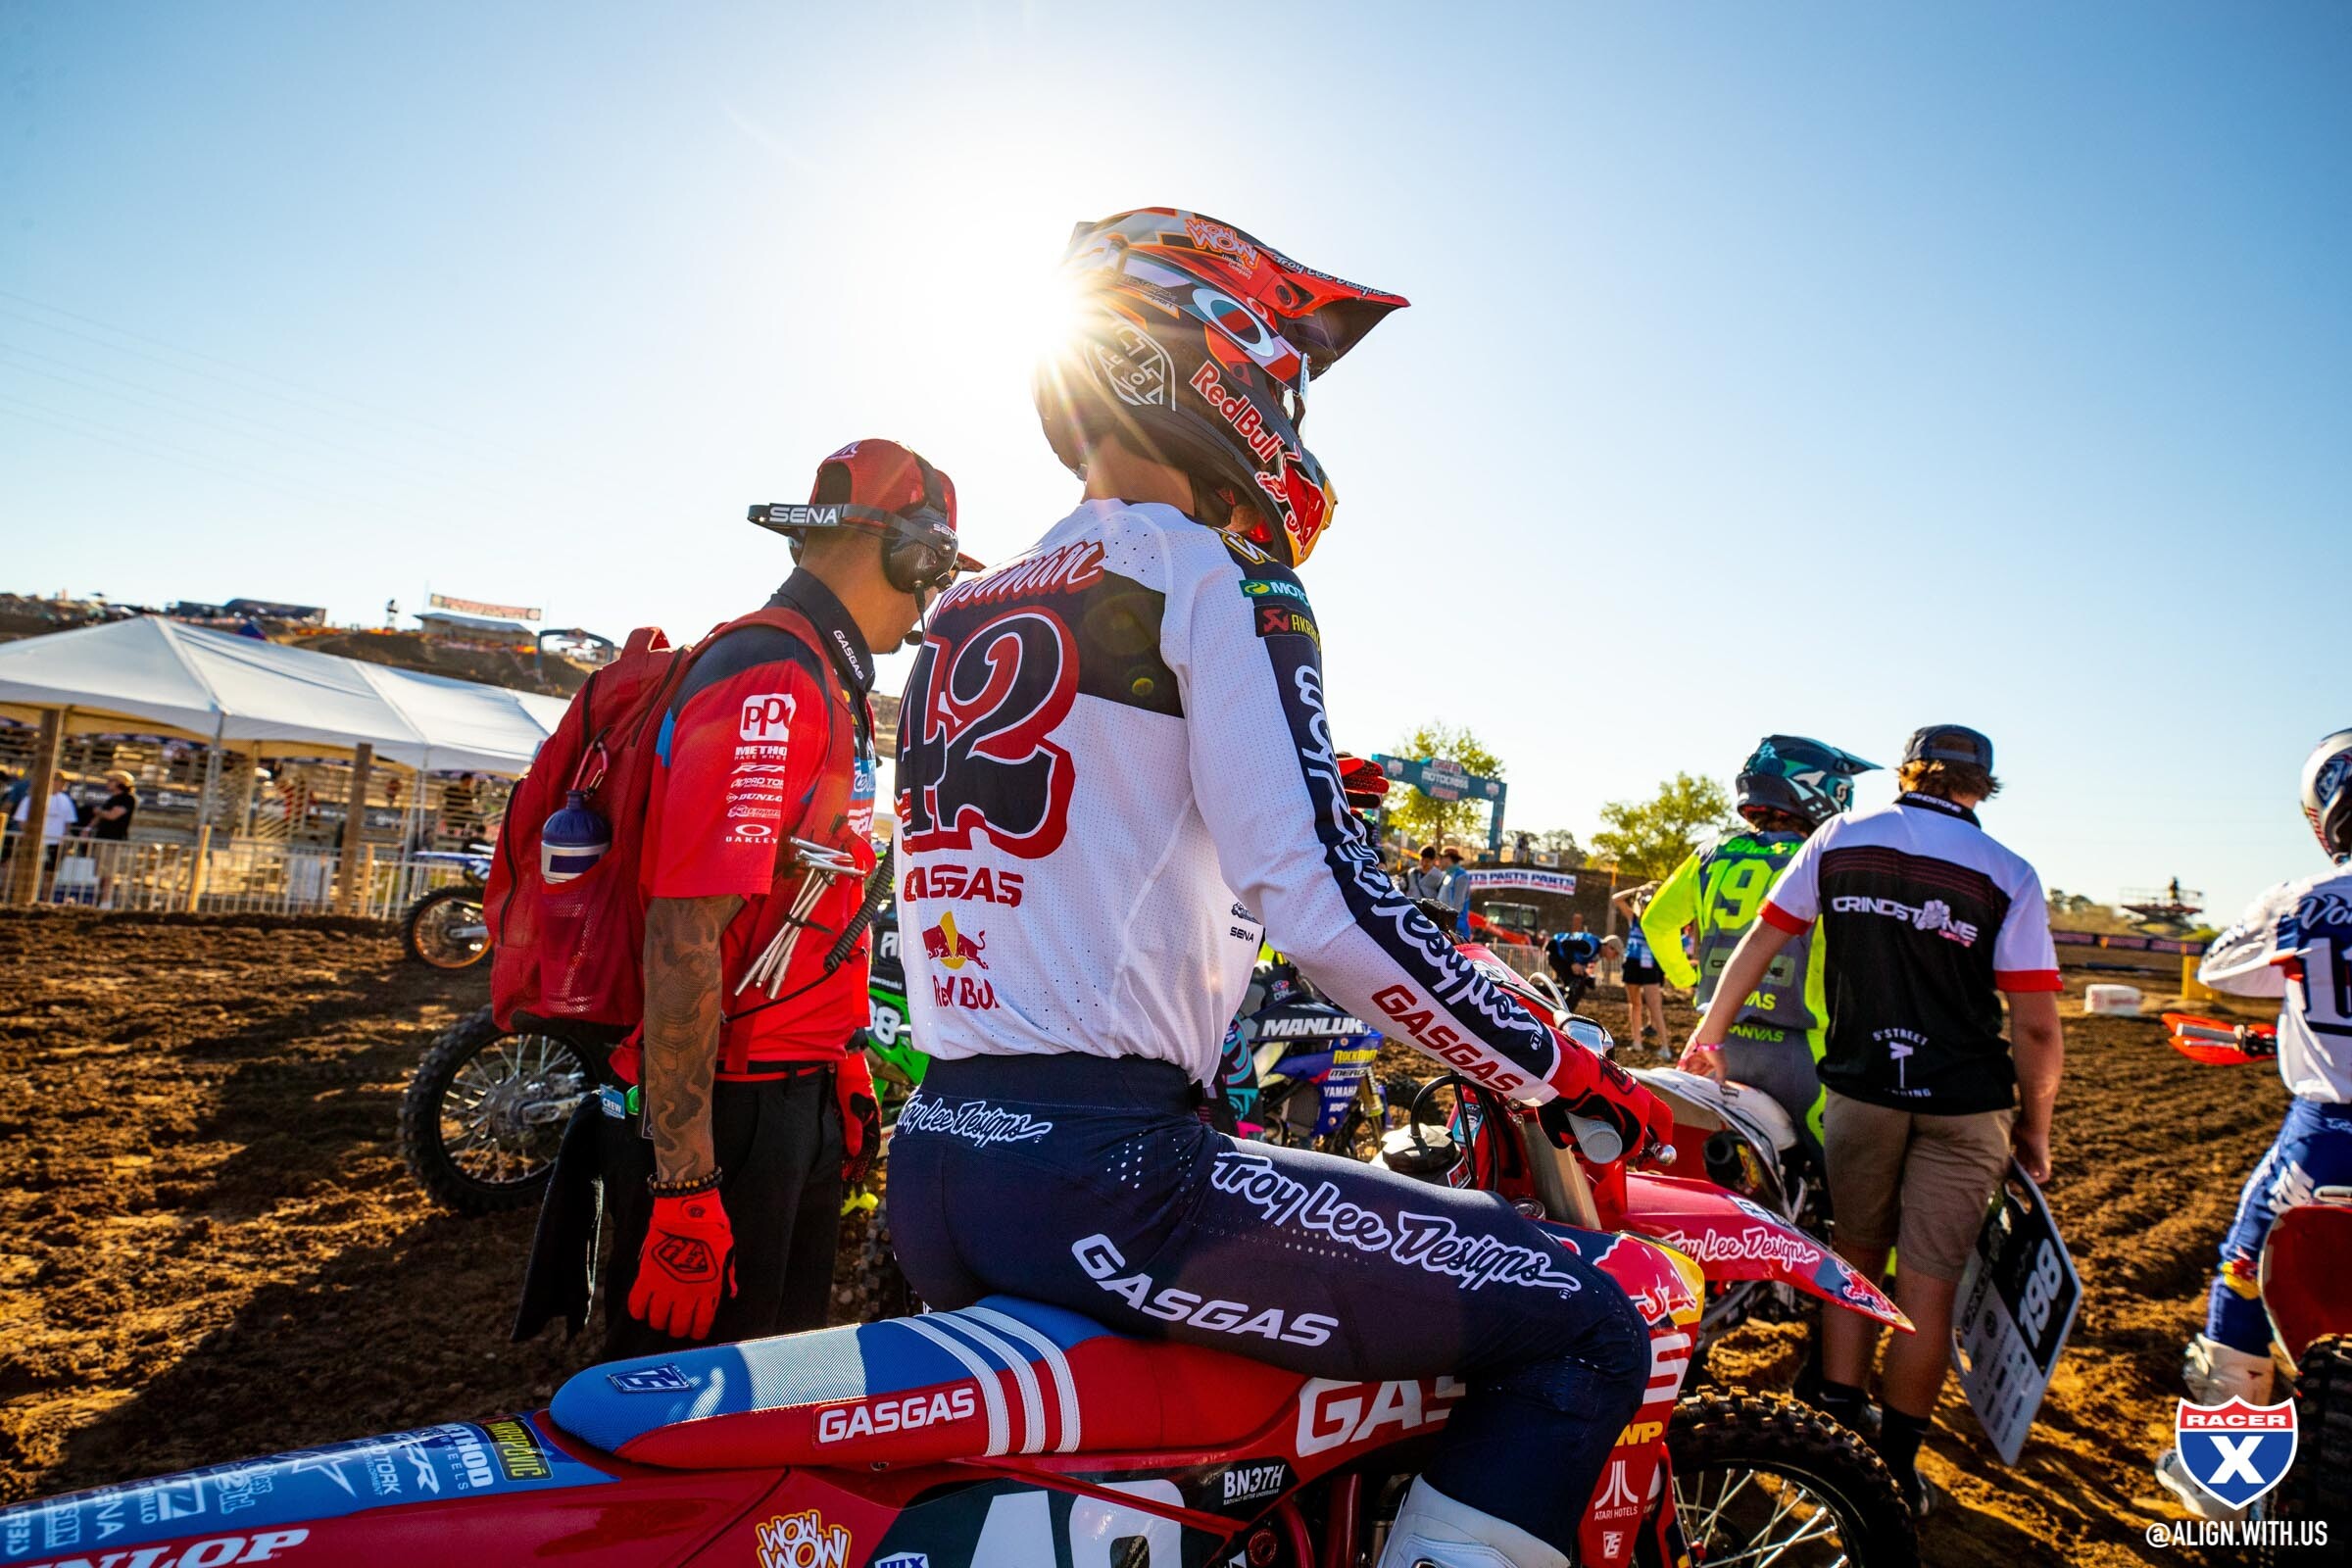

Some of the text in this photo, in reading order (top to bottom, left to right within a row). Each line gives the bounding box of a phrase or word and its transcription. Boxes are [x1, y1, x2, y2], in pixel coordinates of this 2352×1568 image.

[1189, 360, 1286, 464] Red Bull
[769, 507, 838, 524] SENA
[932, 522, 957, 541] SENA
[834, 630, 864, 680] GASGAS
[895, 605, 1079, 858] 42
[1490, 871, 1529, 880] PARTS
[1531, 872, 1576, 887] PARTS
[1229, 926, 1254, 943] SENA
[1261, 1017, 1364, 1037] MANLUK
[1371, 984, 1524, 1092] GASGAS
[1729, 1025, 1785, 1043] ANVAS
[602, 1098, 622, 1114] CREW
[1211, 1151, 1582, 1291] Troy Lee Designs
[1701, 1228, 1744, 1262] Lee
[1742, 1226, 1820, 1272] Designs
[1071, 1233, 1339, 1347] GASGAS
[2019, 1238, 2063, 1349] 198
[818, 1387, 975, 1444] GASGAS
[373, 1455, 402, 1495] TORK
[1224, 1464, 1286, 1498] BN3TH
[760, 1513, 817, 1552] WOW
[1593, 1509, 1613, 1522] ATARI
[1613, 1505, 1639, 1519] HOTELS
